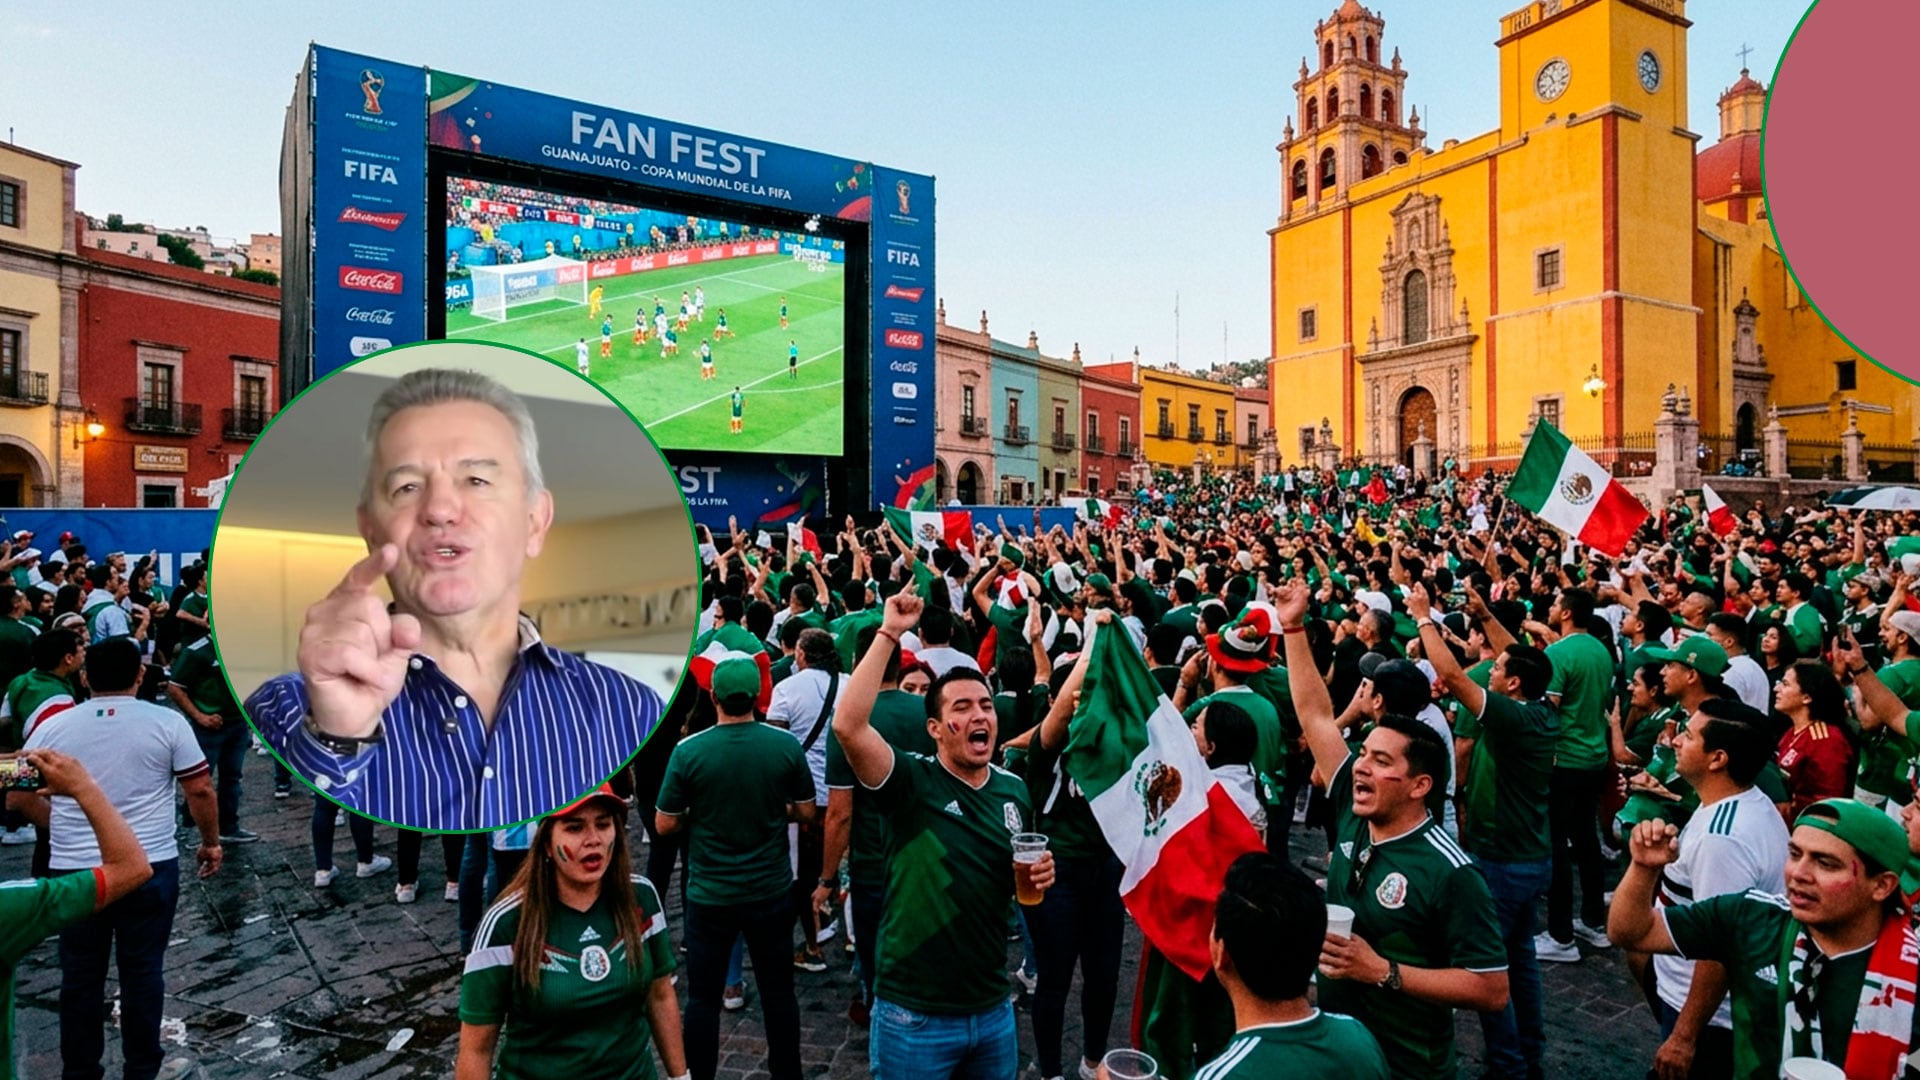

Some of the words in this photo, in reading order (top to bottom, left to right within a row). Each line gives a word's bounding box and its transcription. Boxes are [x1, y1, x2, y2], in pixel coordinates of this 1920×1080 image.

[571, 110, 656, 160] FAN
[670, 131, 767, 179] FEST
[344, 159, 399, 186] FIFA
[541, 144, 631, 172] GUANAJUATO
[640, 163, 675, 180] COPA
[676, 170, 733, 190] MUNDIAL
[733, 179, 750, 193] DE
[751, 183, 766, 196] LA
[768, 187, 792, 200] FIFA
[887, 248, 921, 268] FIFA
[671, 464, 722, 494] ST
